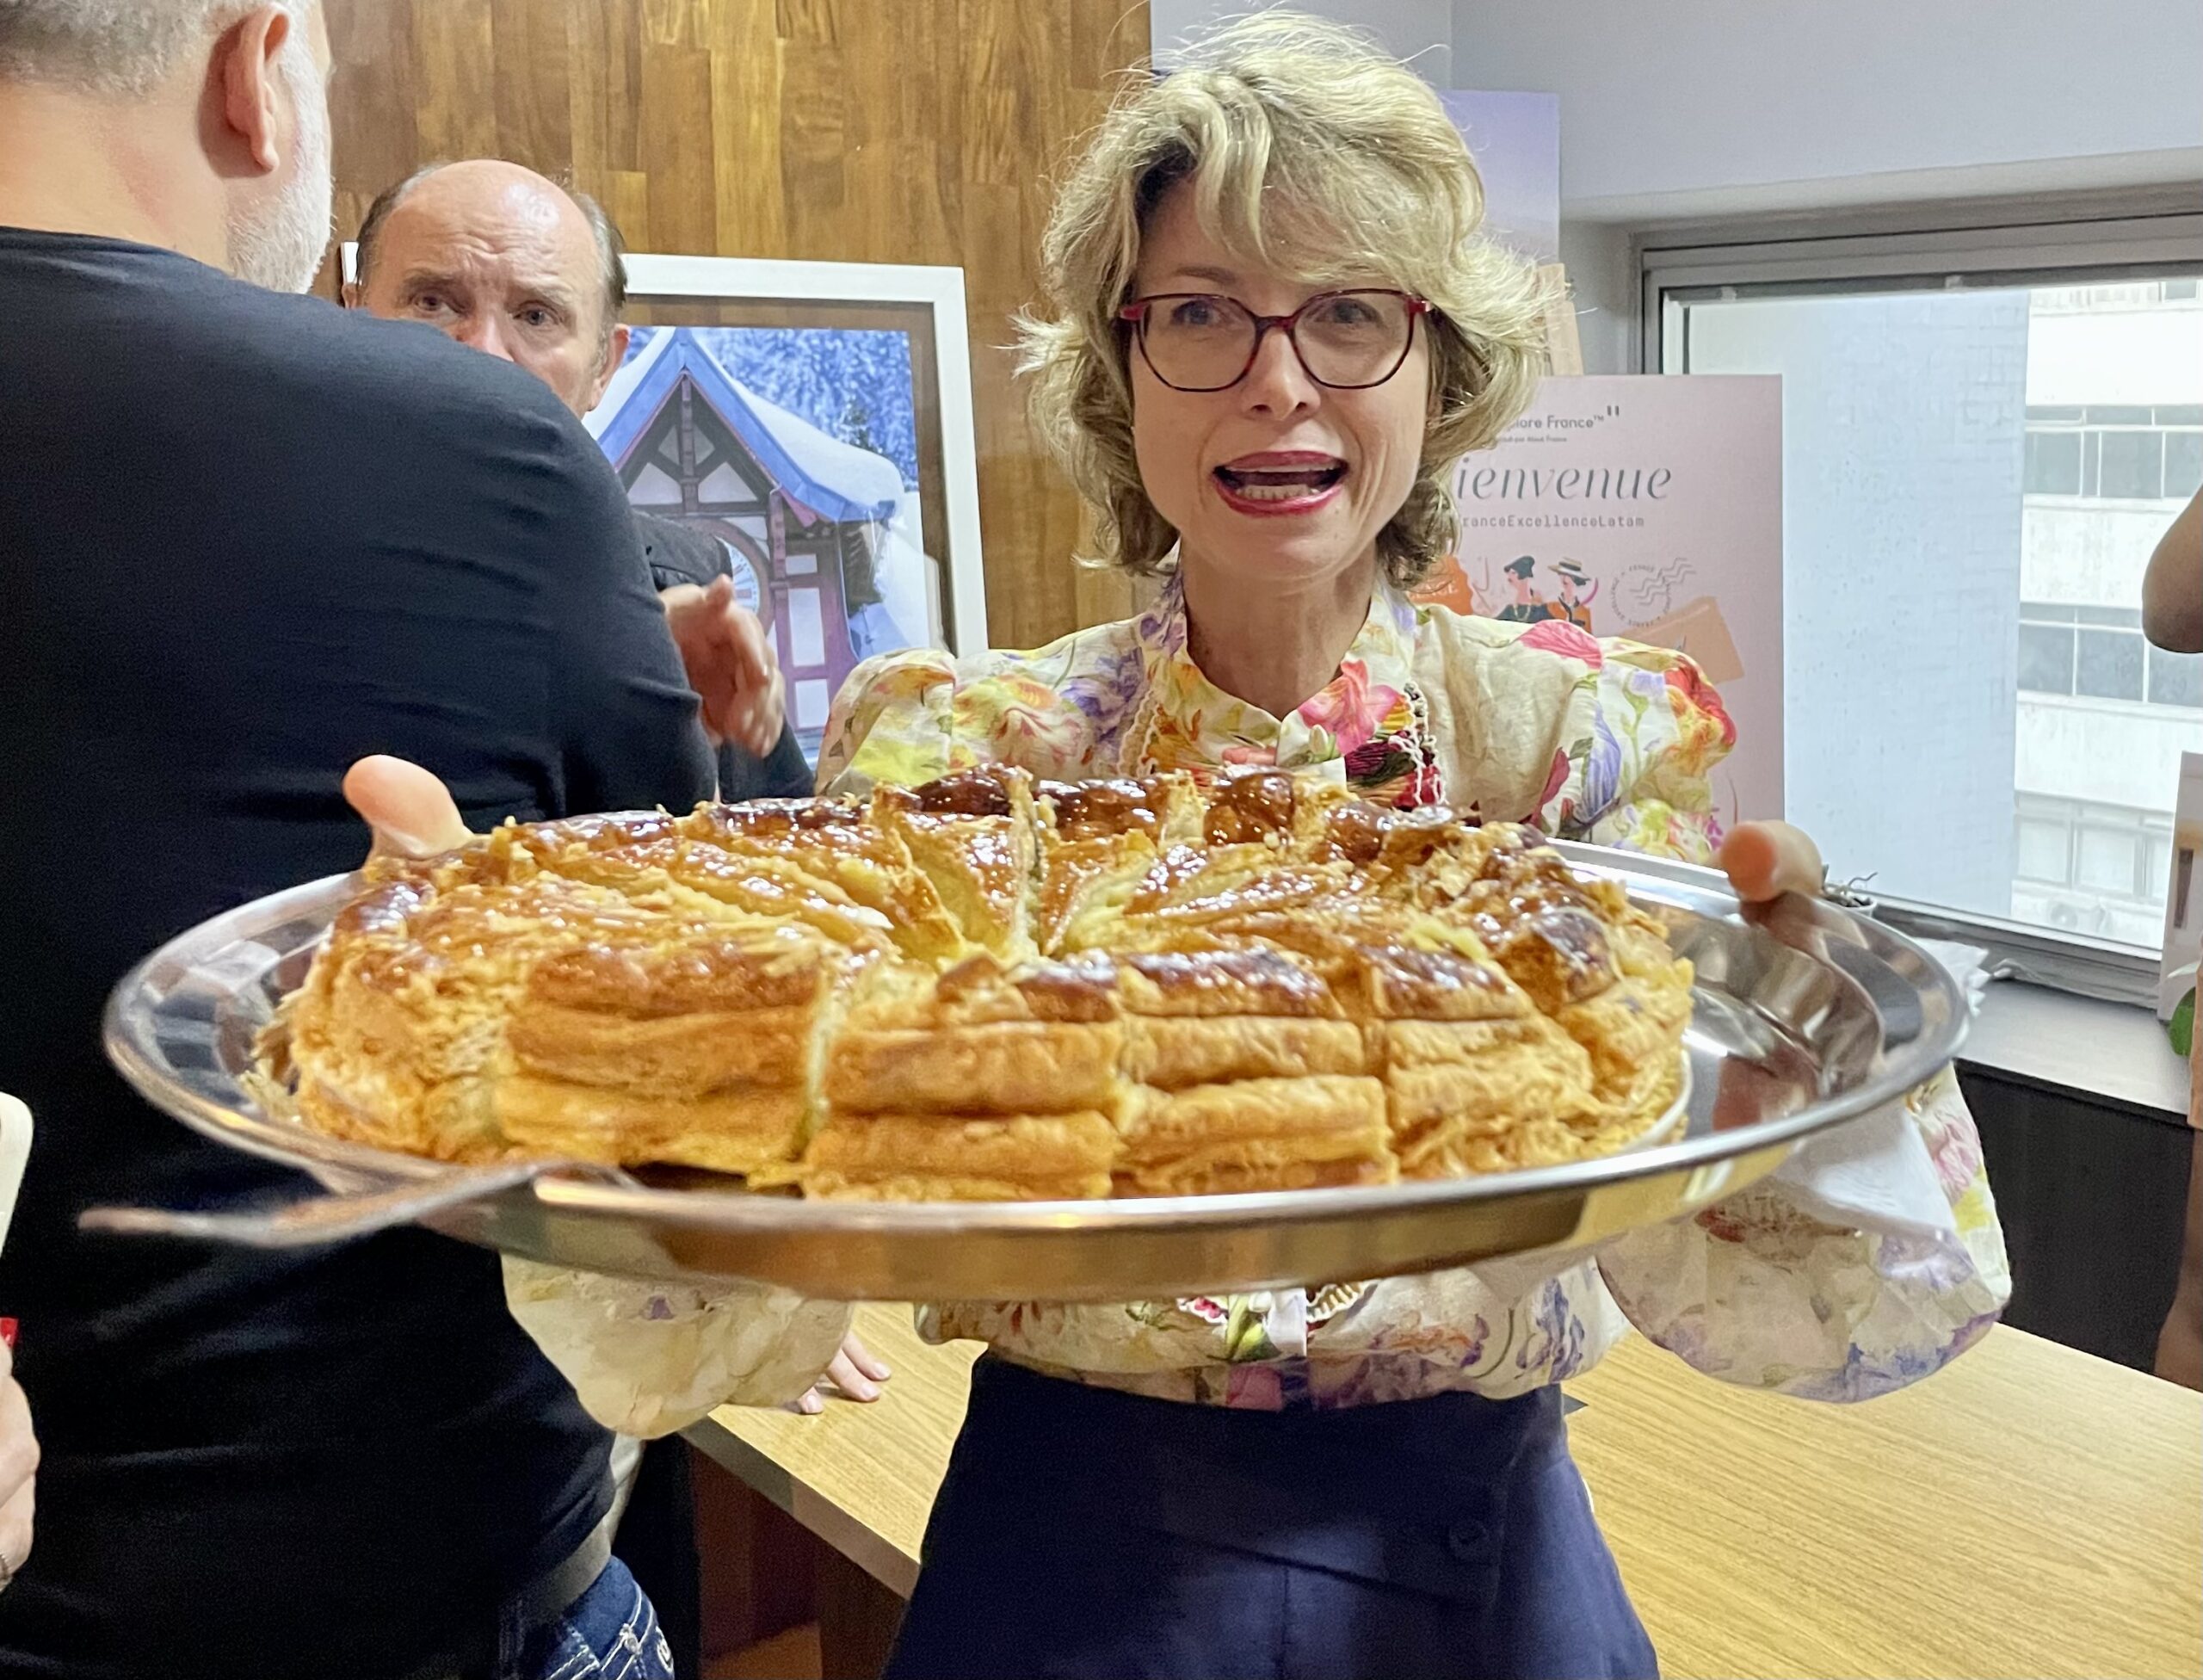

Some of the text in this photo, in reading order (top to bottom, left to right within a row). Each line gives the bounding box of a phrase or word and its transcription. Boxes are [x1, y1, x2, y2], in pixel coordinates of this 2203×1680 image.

[1511, 416, 1542, 429] lore
[1457, 457, 1671, 499] ienvenue
[1463, 515, 1645, 528] ranceExcellenceLatam
